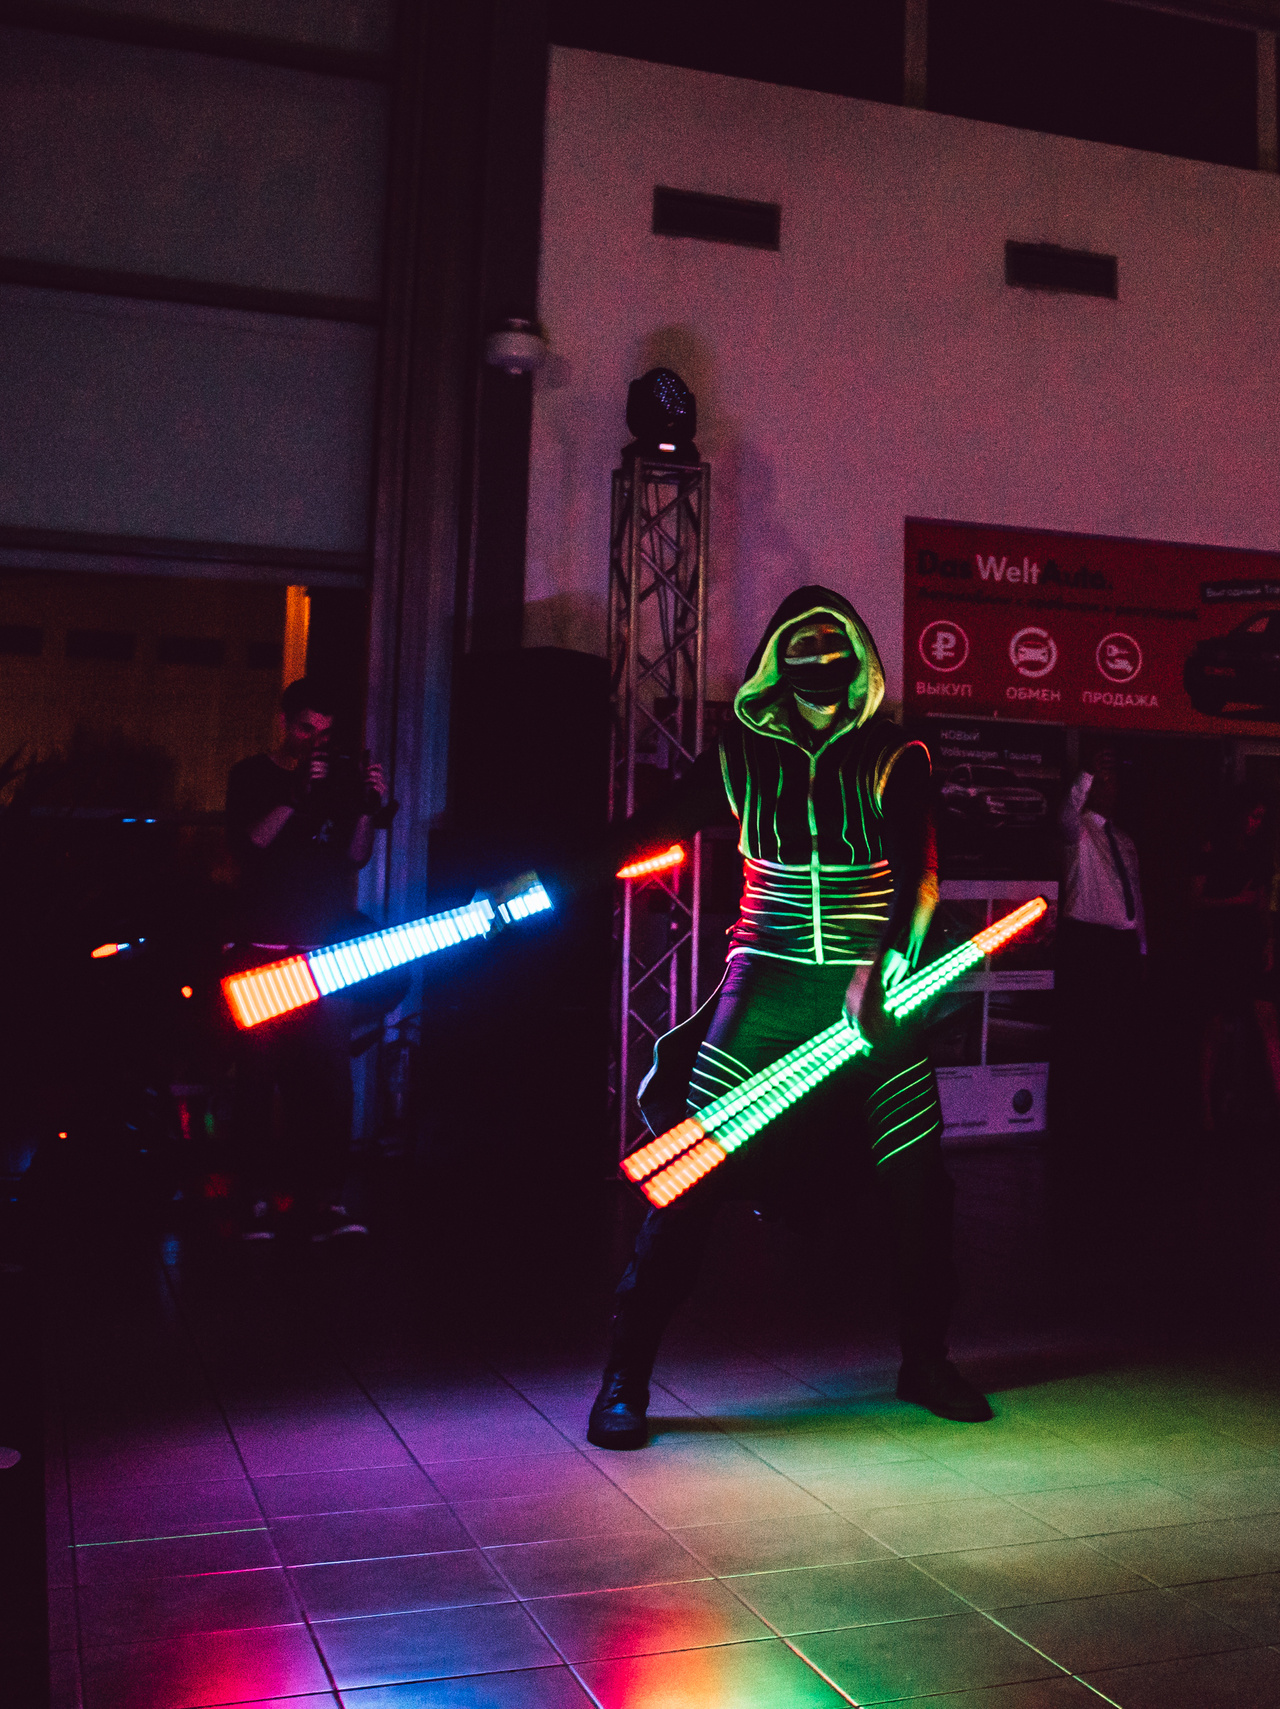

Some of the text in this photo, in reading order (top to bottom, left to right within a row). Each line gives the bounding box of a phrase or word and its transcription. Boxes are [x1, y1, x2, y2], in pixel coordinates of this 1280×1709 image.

[916, 682, 973, 697] ВЫКУП
[1006, 686, 1061, 702] ОБМЕН
[1082, 691, 1159, 707] ПРОДАЖА
[939, 746, 999, 761] Volkswagen
